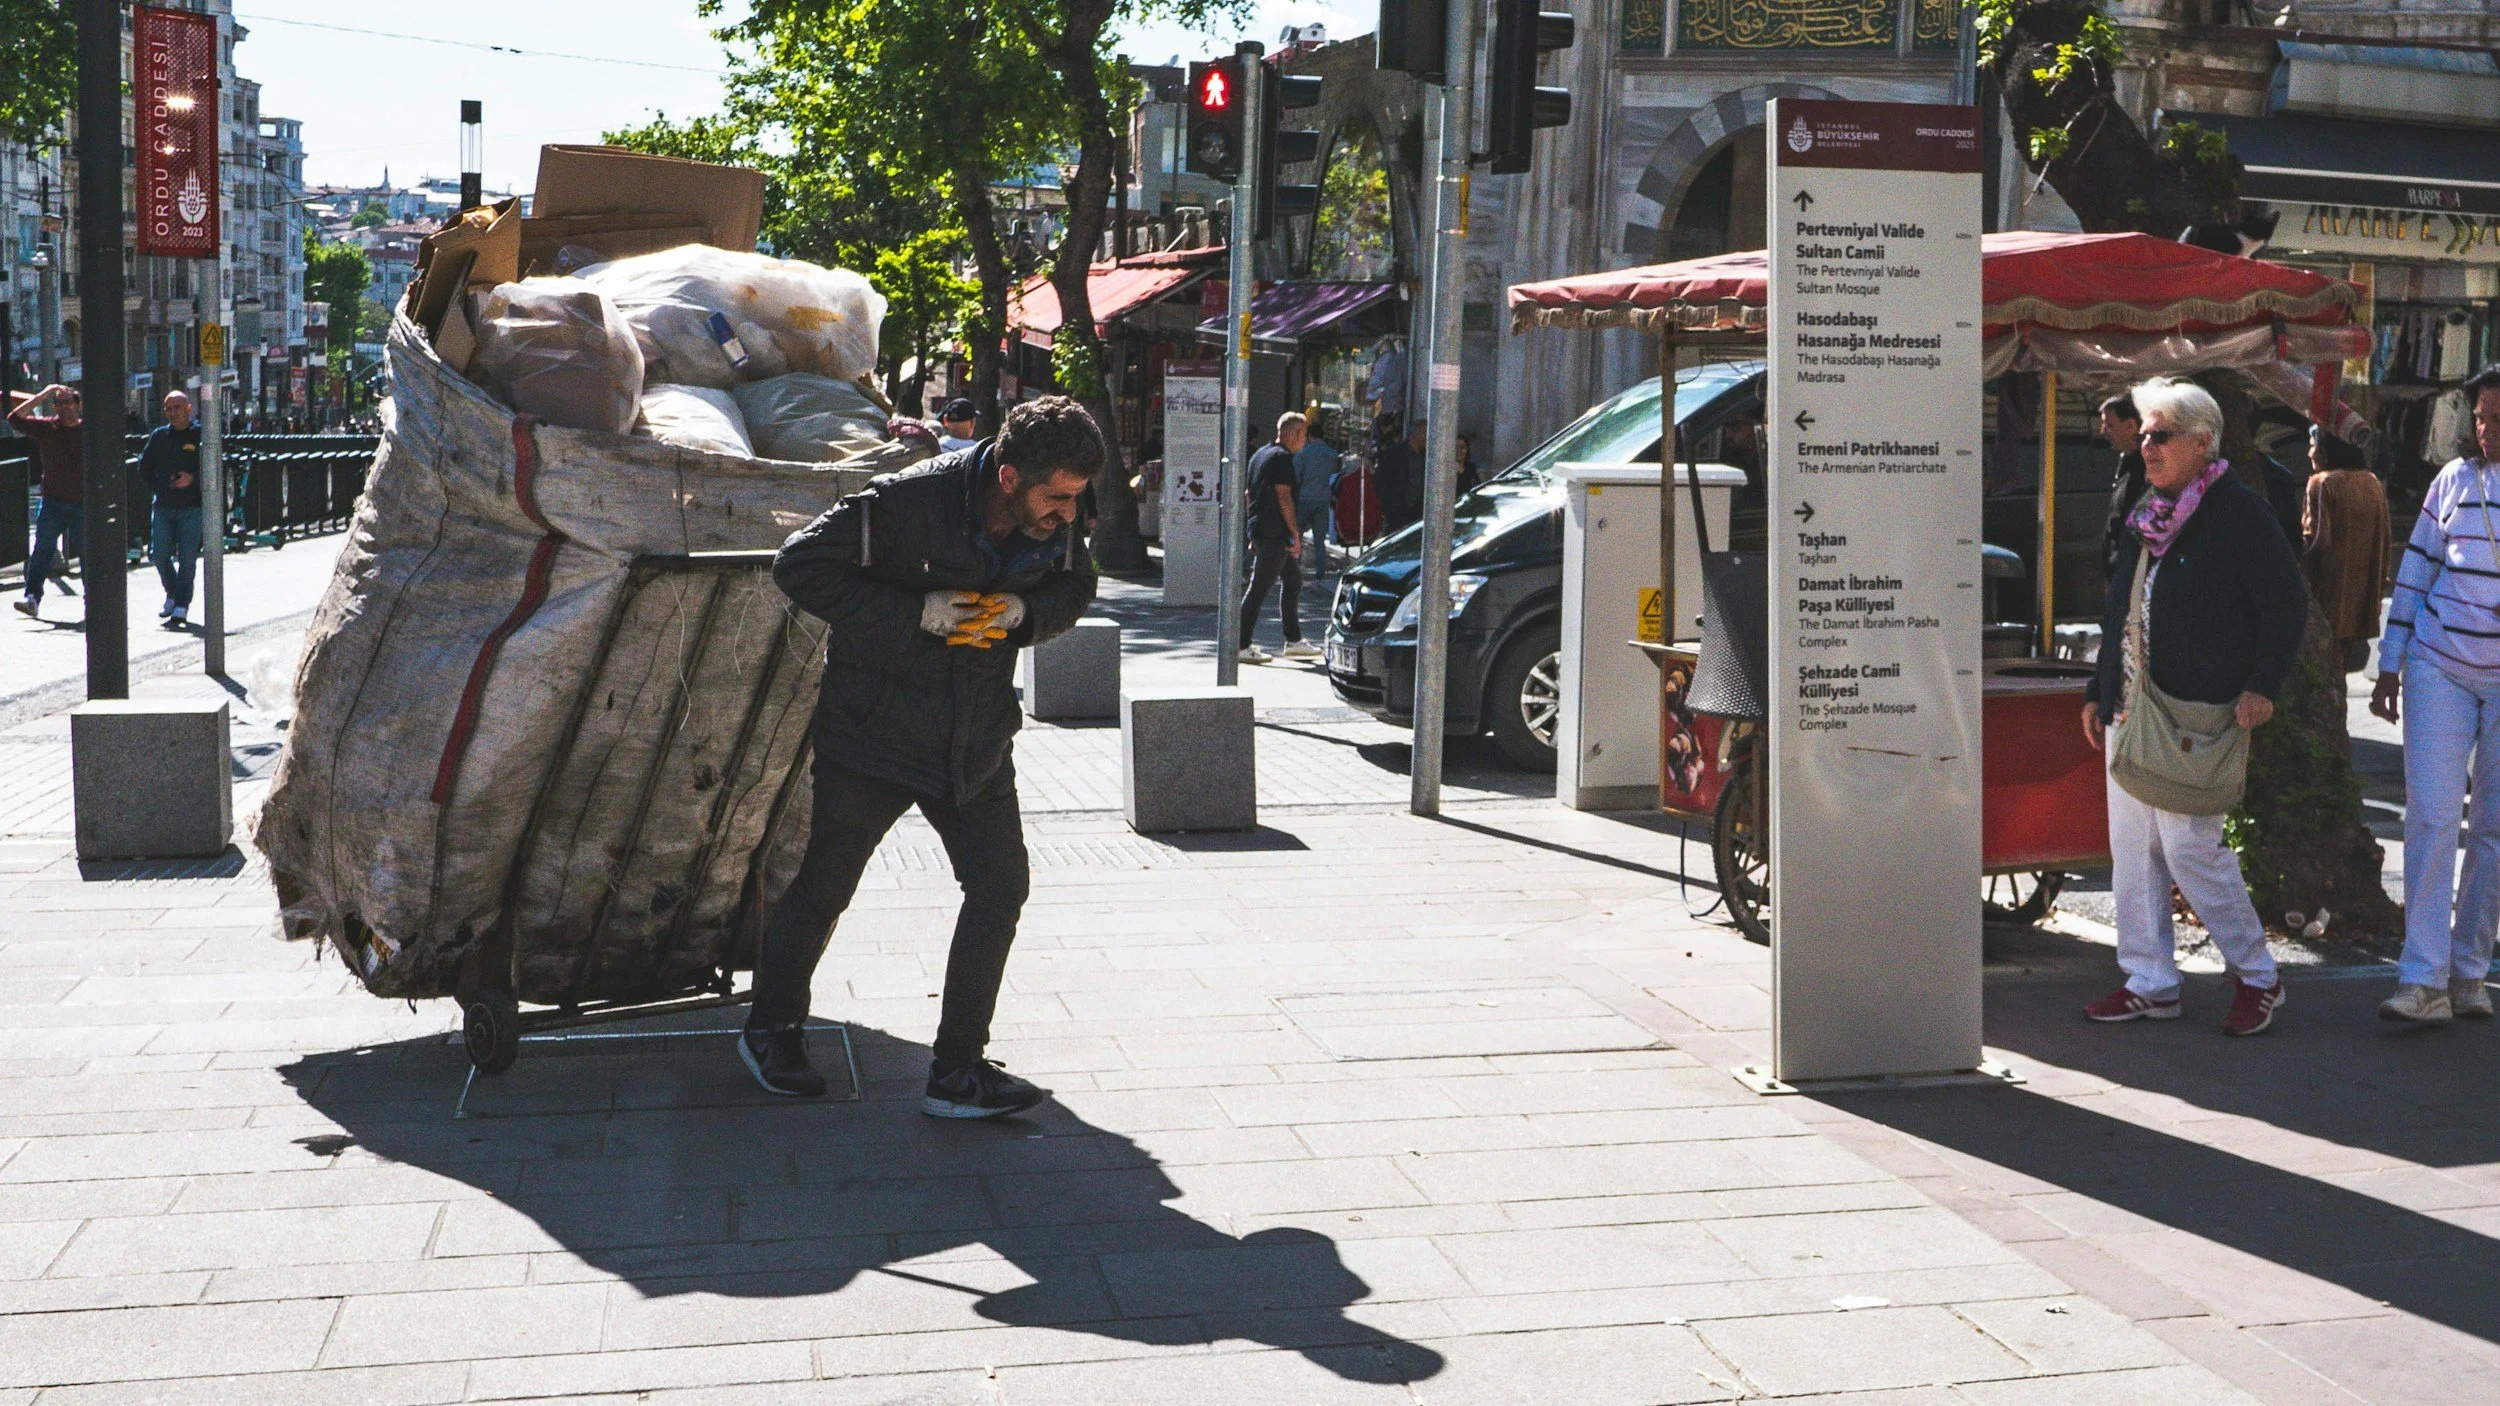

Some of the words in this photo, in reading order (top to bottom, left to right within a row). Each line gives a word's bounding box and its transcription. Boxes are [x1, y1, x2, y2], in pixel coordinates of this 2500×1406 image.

[1915, 127, 1940, 137] ORDU
[155, 168, 169, 236] ORDU
[182, 226, 204, 237] 2023
[1797, 222, 1878, 240] Pertevniyal
[1881, 224, 1925, 238] Valide
[1796, 244, 1842, 258] Sultan
[1845, 245, 1884, 259] Camii
[1796, 264, 1818, 276] The
[1821, 265, 1884, 280] Pertevniyal
[1887, 266, 1920, 278] Valide
[1796, 282, 1832, 294] Sultan
[1836, 283, 1880, 297] Mosque
[1797, 312, 1877, 330] Hasodabaşı
[1797, 334, 1866, 351] Hasanağa
[1870, 334, 1941, 348] Medresesi
[1797, 353, 1818, 365] The
[1797, 371, 1845, 383] Madrasa
[1798, 442, 1847, 456] Ermeni
[1851, 441, 1939, 456] Patrikhanesi
[1798, 462, 1819, 473] The
[1822, 463, 1875, 473] Armenian
[1879, 462, 1947, 473] Patriarchate
[1798, 532, 1846, 550] Taşhan
[1799, 578, 1845, 591] Damat
[1849, 574, 1902, 590] İbrahim
[1799, 599, 1832, 616] Paşa
[1835, 597, 1894, 615] Külliyesi
[1799, 618, 1820, 630] The
[1823, 618, 1859, 629] Damat
[1907, 617, 1939, 628] Pasha
[1798, 636, 1847, 649] Complex
[1799, 665, 1858, 682] Şehzade
[1861, 663, 1900, 678] Camii
[1799, 683, 1859, 701] Külliyesi
[1799, 704, 1820, 715] The
[1873, 703, 1916, 715] Mosque
[1799, 719, 1847, 732] Complex
